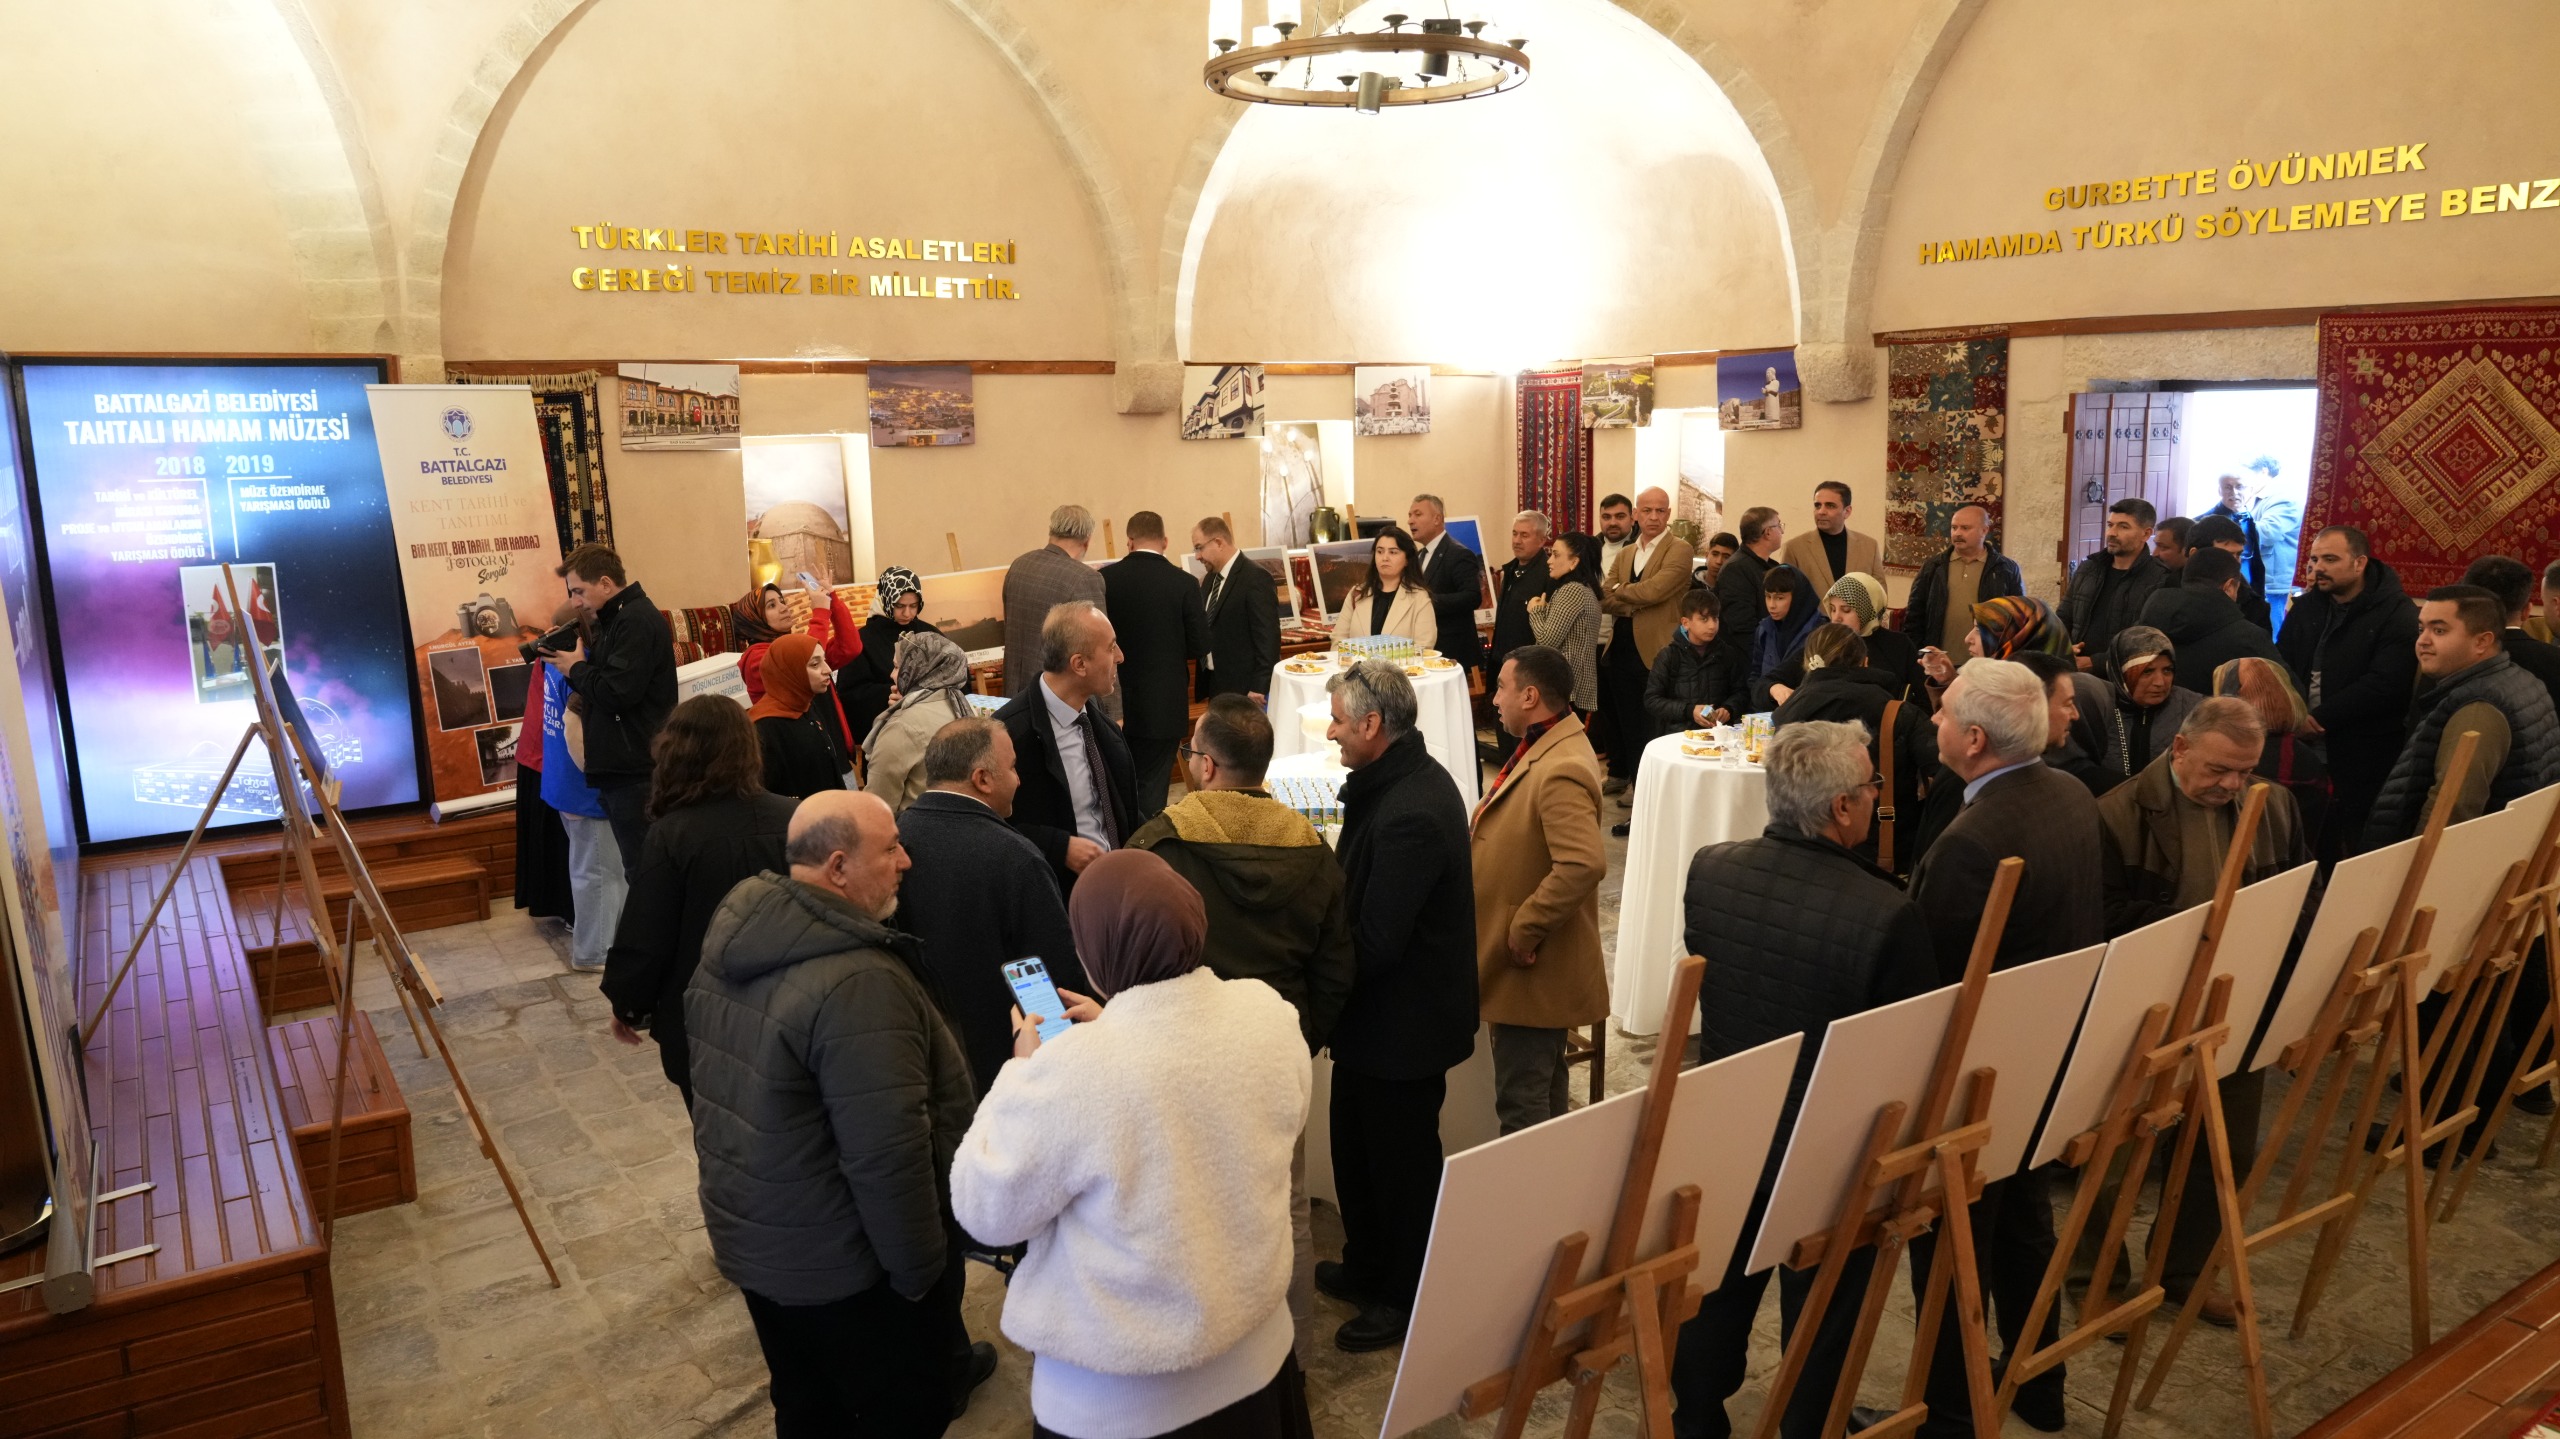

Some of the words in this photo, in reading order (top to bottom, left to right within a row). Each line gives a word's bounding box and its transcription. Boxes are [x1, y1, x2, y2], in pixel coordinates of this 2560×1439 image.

[2043, 168, 2217, 212] GURBETTE
[2227, 142, 2429, 192] ÖVÜNMEK
[1918, 230, 2062, 266] HAMAMDA
[2071, 214, 2184, 251] TÜRKÜ
[2195, 192, 2427, 239] SÖYLEMEYE
[570, 221, 728, 254] TÜRKLER
[735, 228, 838, 257] TARİHİ
[848, 236, 1016, 264] ASALETLERİ
[571, 263, 695, 293] GEREĞİ
[705, 267, 800, 295] TEMİZ
[810, 269, 861, 297] BİR
[869, 271, 1020, 300] MİLLETTİR.
[94, 389, 211, 414] BATTALGAZİ
[215, 389, 318, 413] BELEDİYESİ
[64, 420, 165, 445] TAHTALI
[172, 419, 262, 443] HAMAM
[269, 413, 350, 441] MÜZESİ
[453, 448, 471, 456] T.C.
[156, 455, 206, 475] 2018
[225, 454, 274, 474] 2019
[420, 458, 507, 474] BATTALGAZİ
[441, 475, 493, 486] BELEDİYESİ
[240, 485, 268, 498] MÜZE
[269, 484, 326, 498] ÖZENDİRME
[240, 499, 296, 514] YARIŞMASI
[296, 497, 331, 510] ÖDÜLÜ
[409, 498, 453, 513] KENT
[457, 494, 509, 511] TARİHİ
[111, 549, 169, 563] YARIŞMASI
[170, 545, 205, 558] ÖDÜLÜ
[411, 543, 427, 559] BİR
[452, 540, 467, 554] BİR
[494, 536, 509, 552] BİR
[509, 535, 540, 551] KADRAJ
